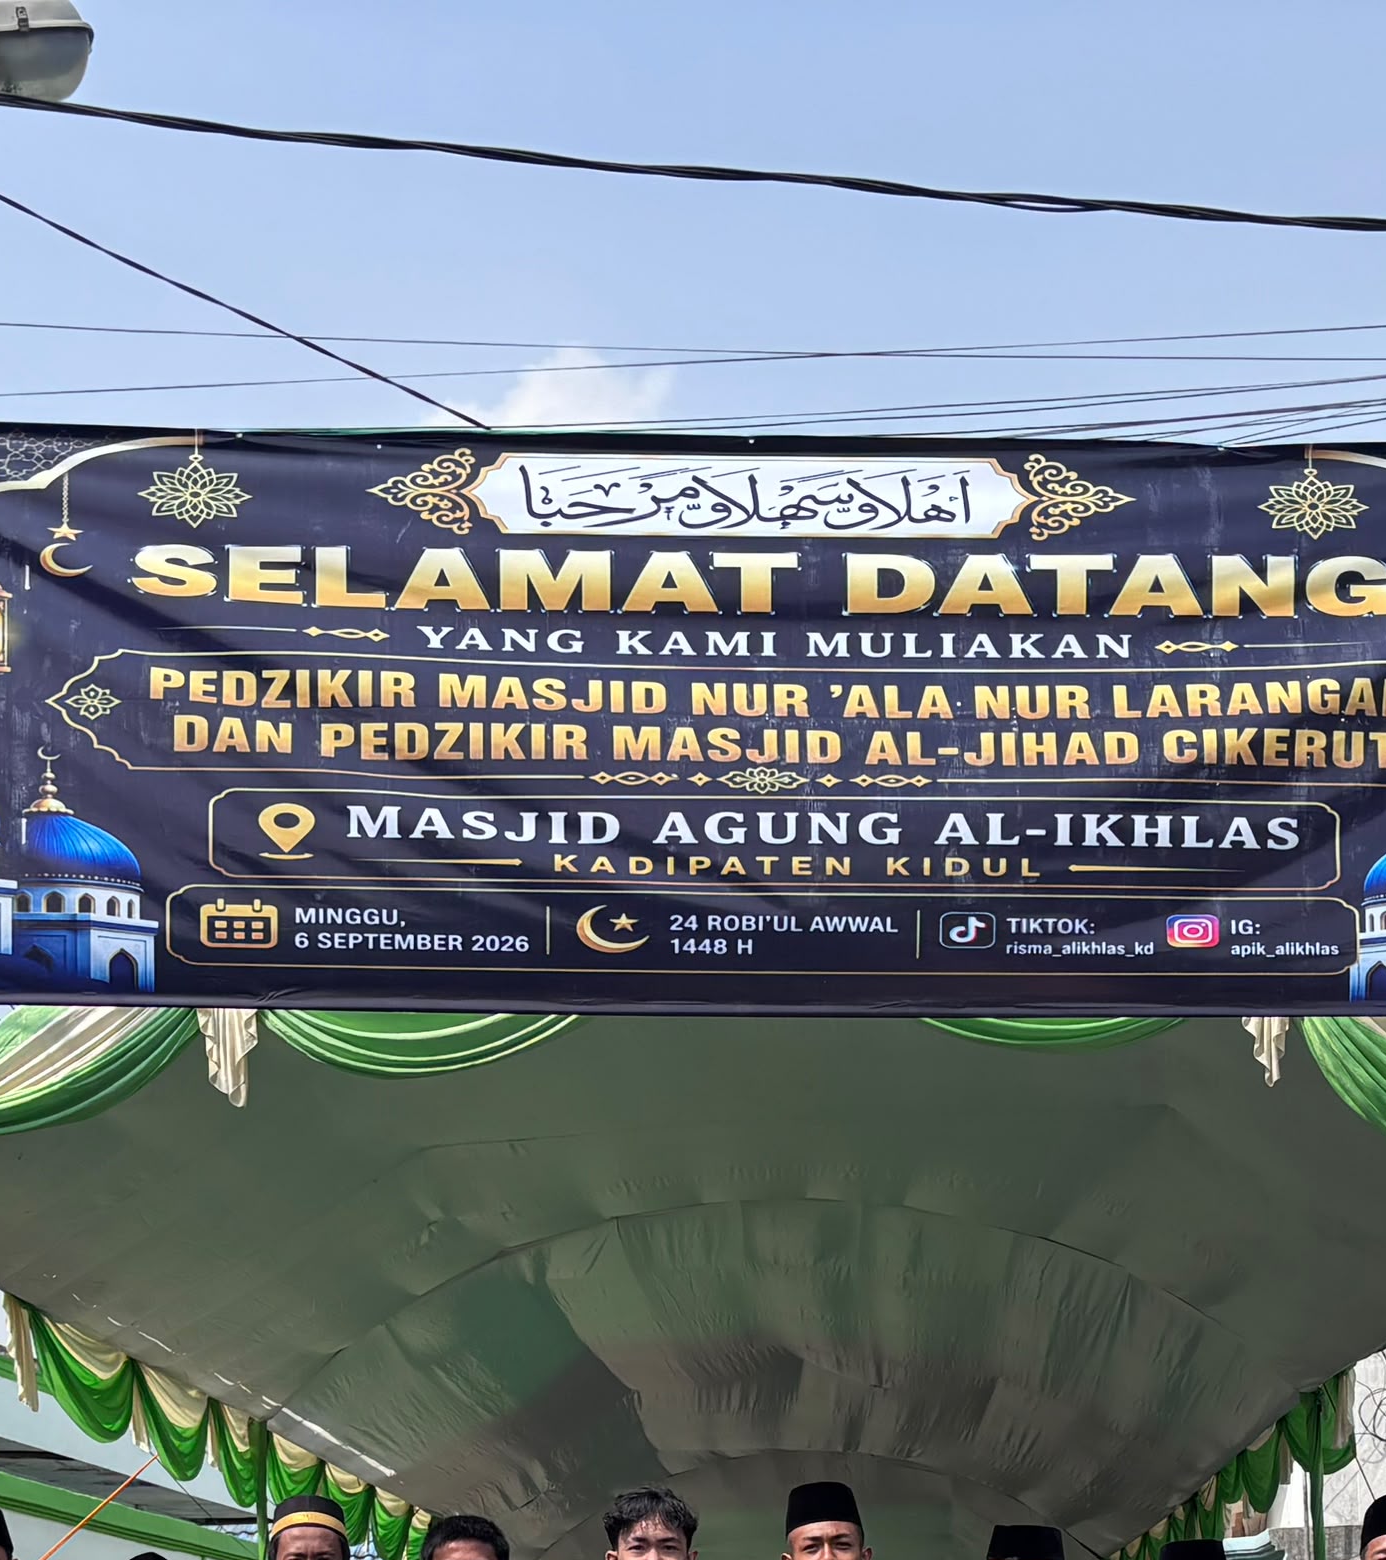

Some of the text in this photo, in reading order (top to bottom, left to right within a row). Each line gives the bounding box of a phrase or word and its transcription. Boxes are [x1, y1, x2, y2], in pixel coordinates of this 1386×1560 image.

[131, 544, 800, 613] SELAMAT
[417, 625, 1132, 659] YANG KAMI MULIAKAN
[149, 666, 416, 709] PEDZIKIR
[438, 672, 668, 715] MASJID
[692, 682, 809, 718] NUR
[974, 683, 1090, 719] NUR
[173, 714, 293, 754] DAN
[320, 721, 588, 761] PEDZIKIR
[615, 725, 842, 764] MASJID
[865, 729, 1139, 767] AL-JIHAD
[346, 804, 1299, 851] MASJID AGUNG AL-IKHLAS
[554, 854, 1040, 877] KADIPATEN KIDUL
[295, 907, 405, 927] MINGGU,
[670, 915, 698, 931] 24
[810, 916, 898, 932] AWWAL
[1006, 918, 1094, 934] TIKTOK:
[1231, 919, 1260, 934] IG:
[295, 932, 529, 952] 6 SEPTEMBER 2026
[671, 938, 752, 954] 1448 H
[1006, 941, 1154, 957] risma_alikhlas_kd
[1231, 942, 1339, 957] apik_alikhlas
